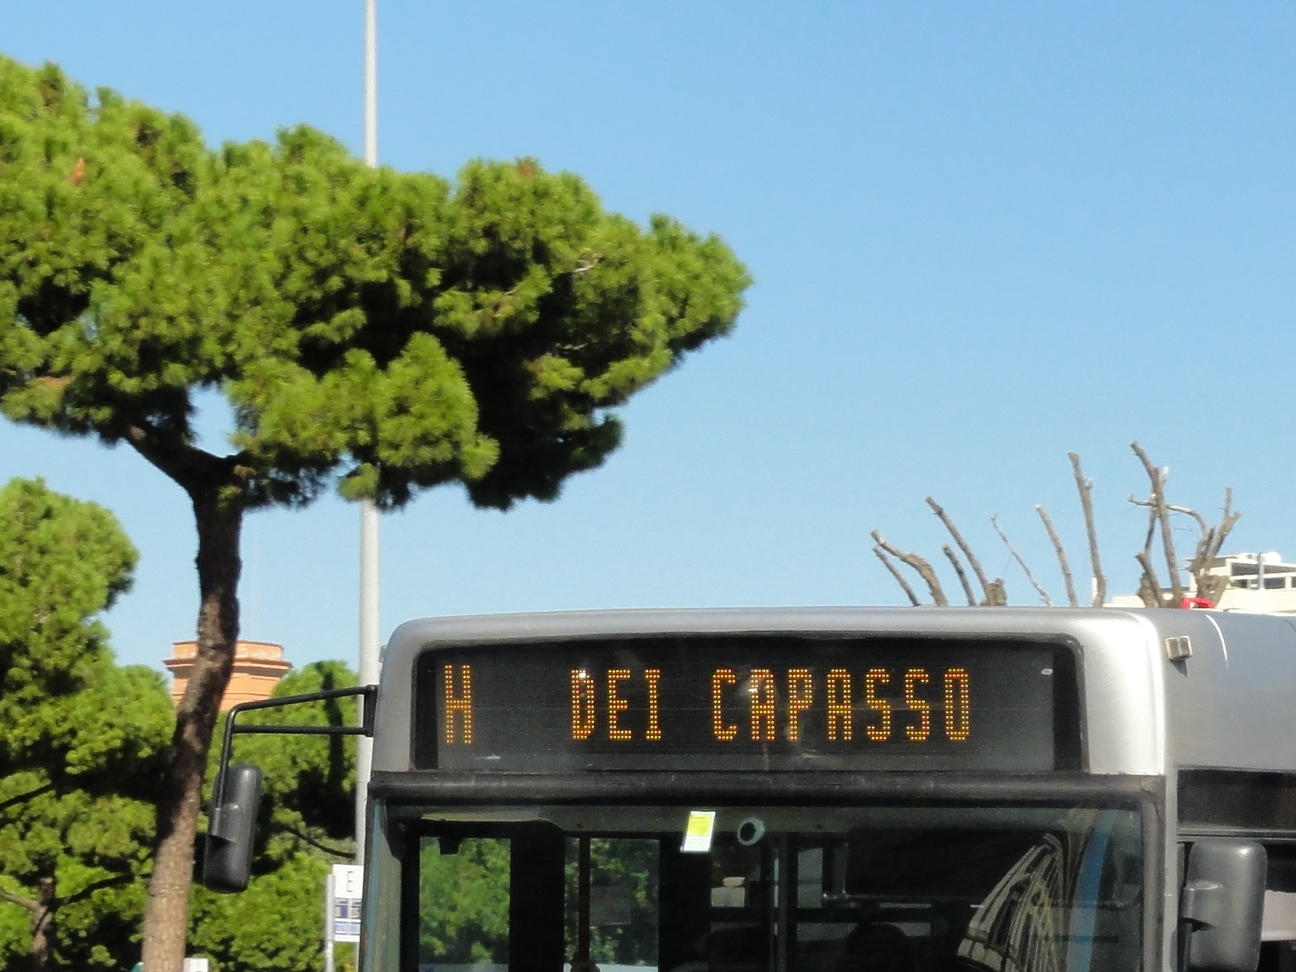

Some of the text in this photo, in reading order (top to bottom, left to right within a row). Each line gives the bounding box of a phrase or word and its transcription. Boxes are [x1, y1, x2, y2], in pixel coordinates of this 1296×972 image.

[443, 664, 971, 745] H DEI CAPASSO
